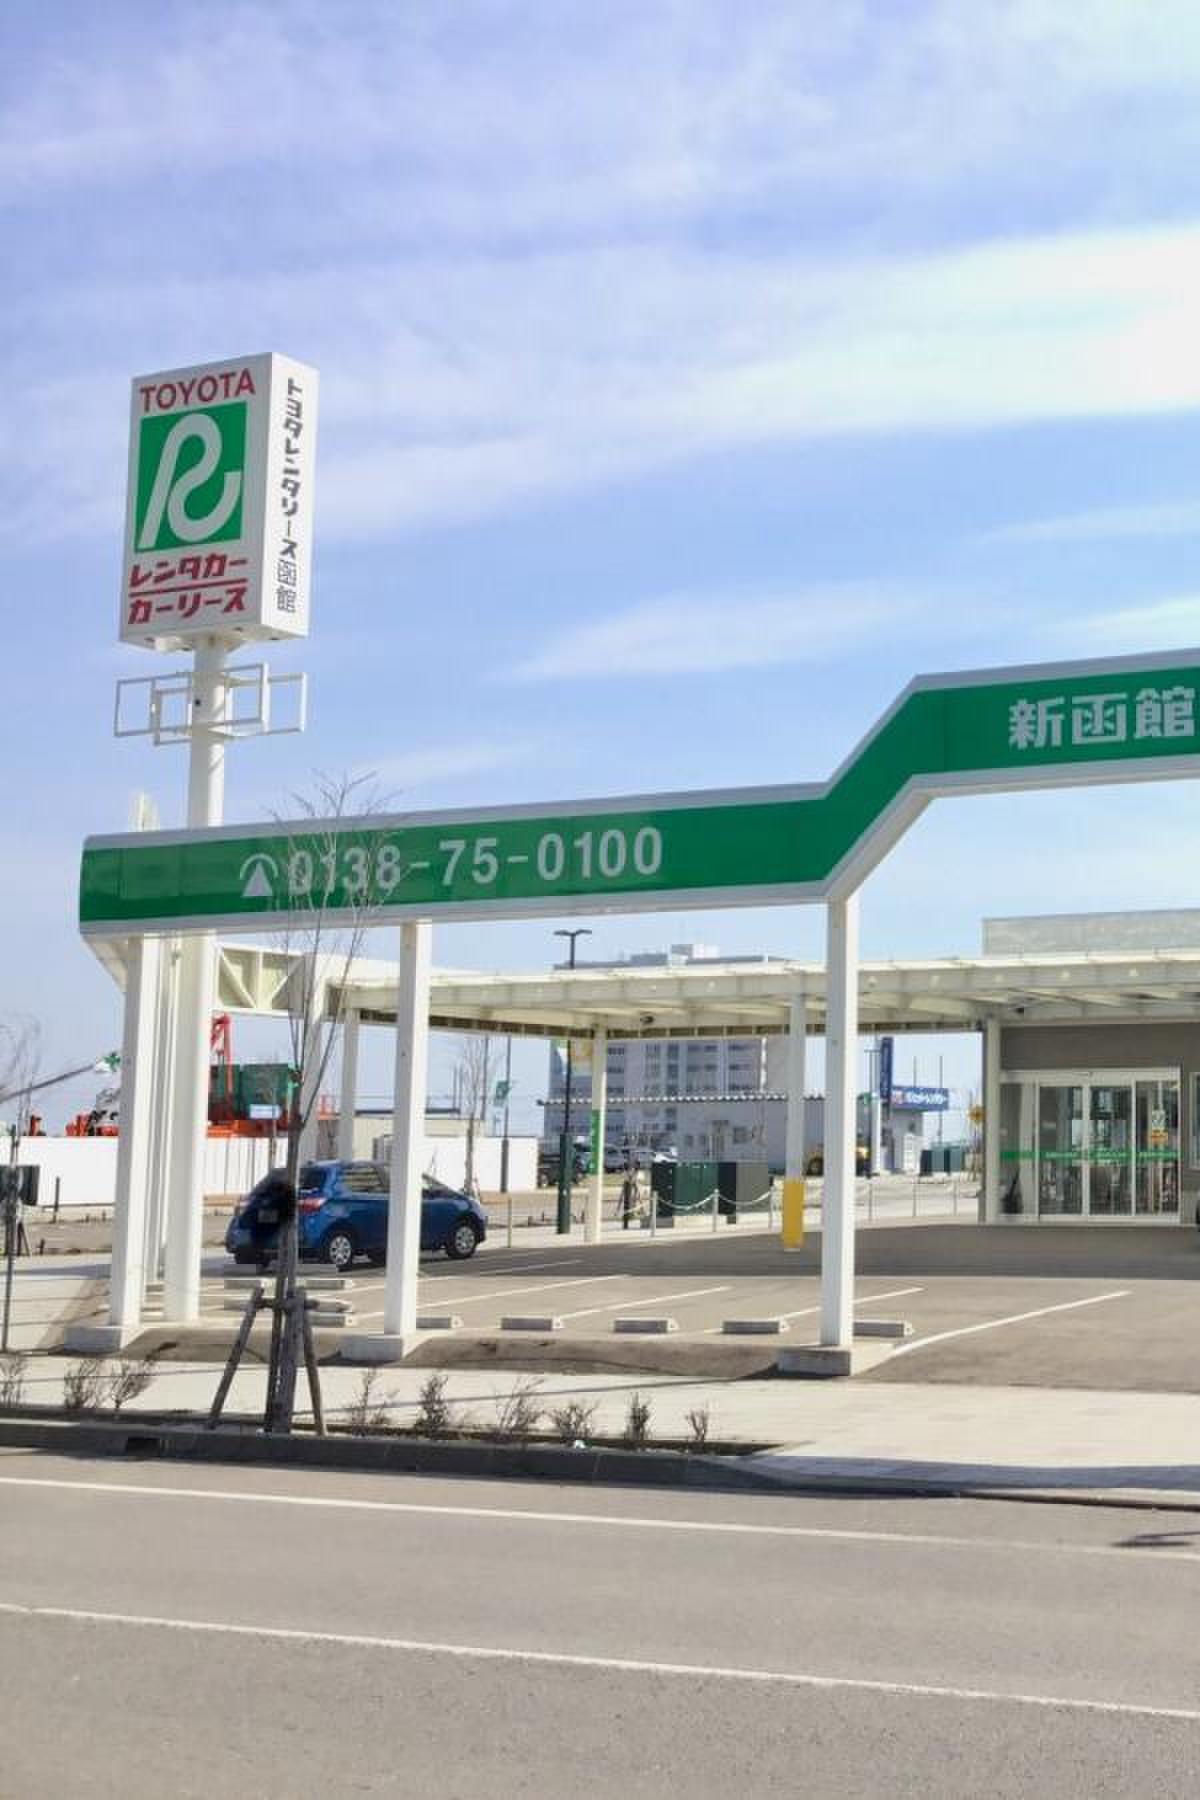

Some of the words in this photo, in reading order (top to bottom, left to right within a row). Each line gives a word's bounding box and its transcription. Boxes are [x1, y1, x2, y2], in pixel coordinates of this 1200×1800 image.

[140, 368, 255, 412] TOYOTA
[276, 378, 303, 613] トヨタレンタリース函館
[129, 553, 247, 587] レンタカー
[127, 588, 247, 624] カーリース
[289, 827, 663, 896] 0138-75-0100
